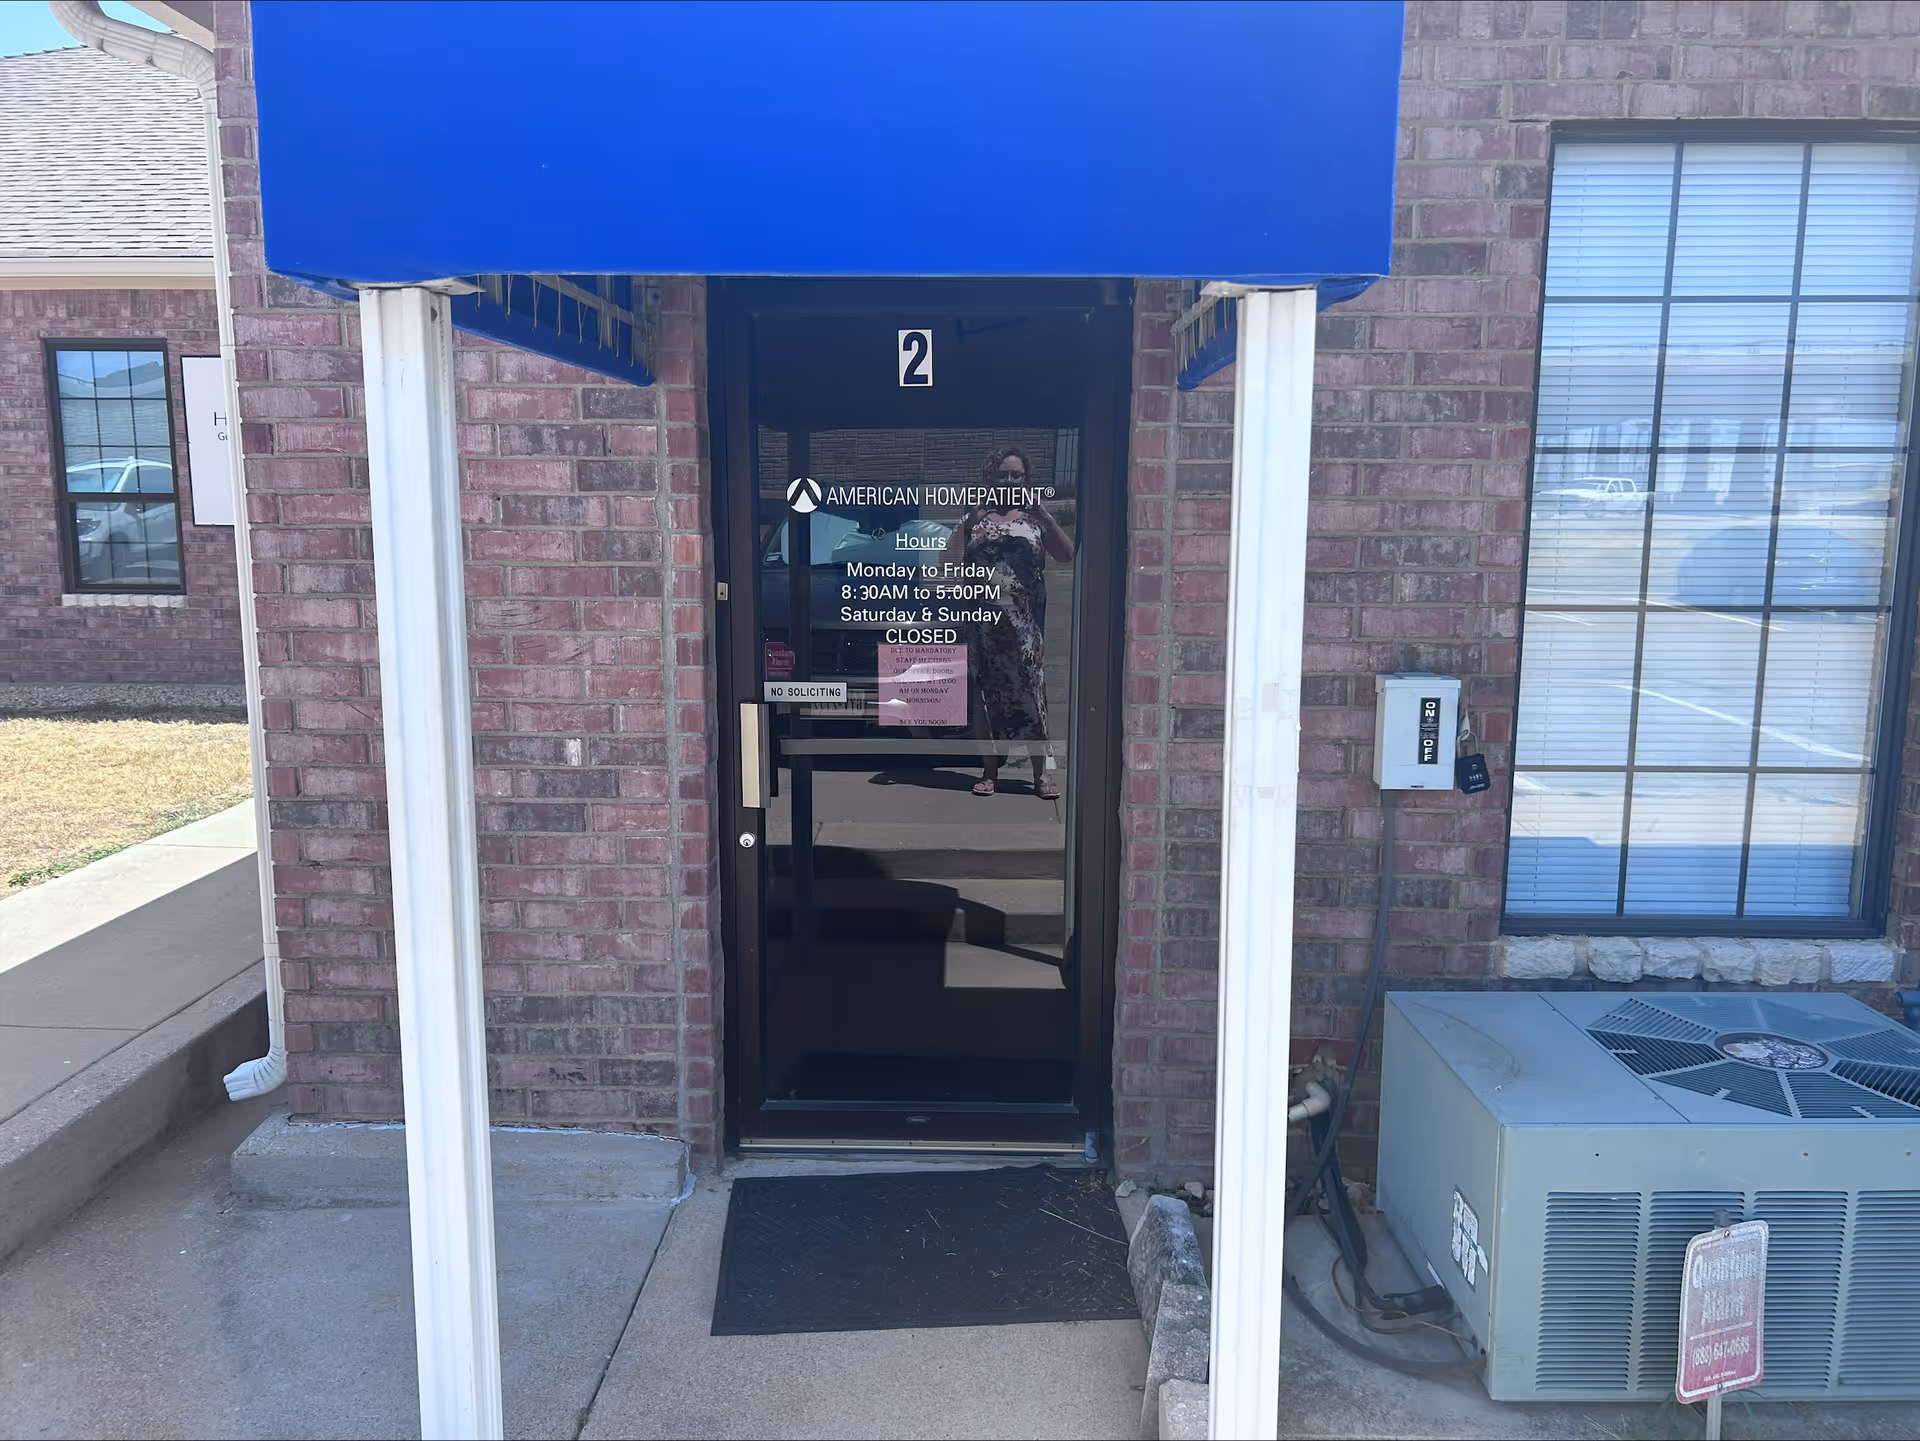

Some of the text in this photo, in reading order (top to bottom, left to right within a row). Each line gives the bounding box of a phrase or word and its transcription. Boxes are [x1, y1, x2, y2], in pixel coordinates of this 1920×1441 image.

[902, 331, 929, 385] 2
[826, 486, 919, 506] AMERICAN
[895, 533, 947, 550] Hours
[847, 562, 996, 581] Monday to Friday
[841, 584, 1001, 600] 8:30AM to 5:00PM
[840, 606, 1002, 625] Saturday & Sunday
[886, 628, 957, 644] CLOSED
[770, 687, 841, 697] NO SOLICITING
[1425, 701, 1436, 717] ON
[1423, 739, 1434, 762] OFF
[1701, 1292, 1745, 1325] Alarm
